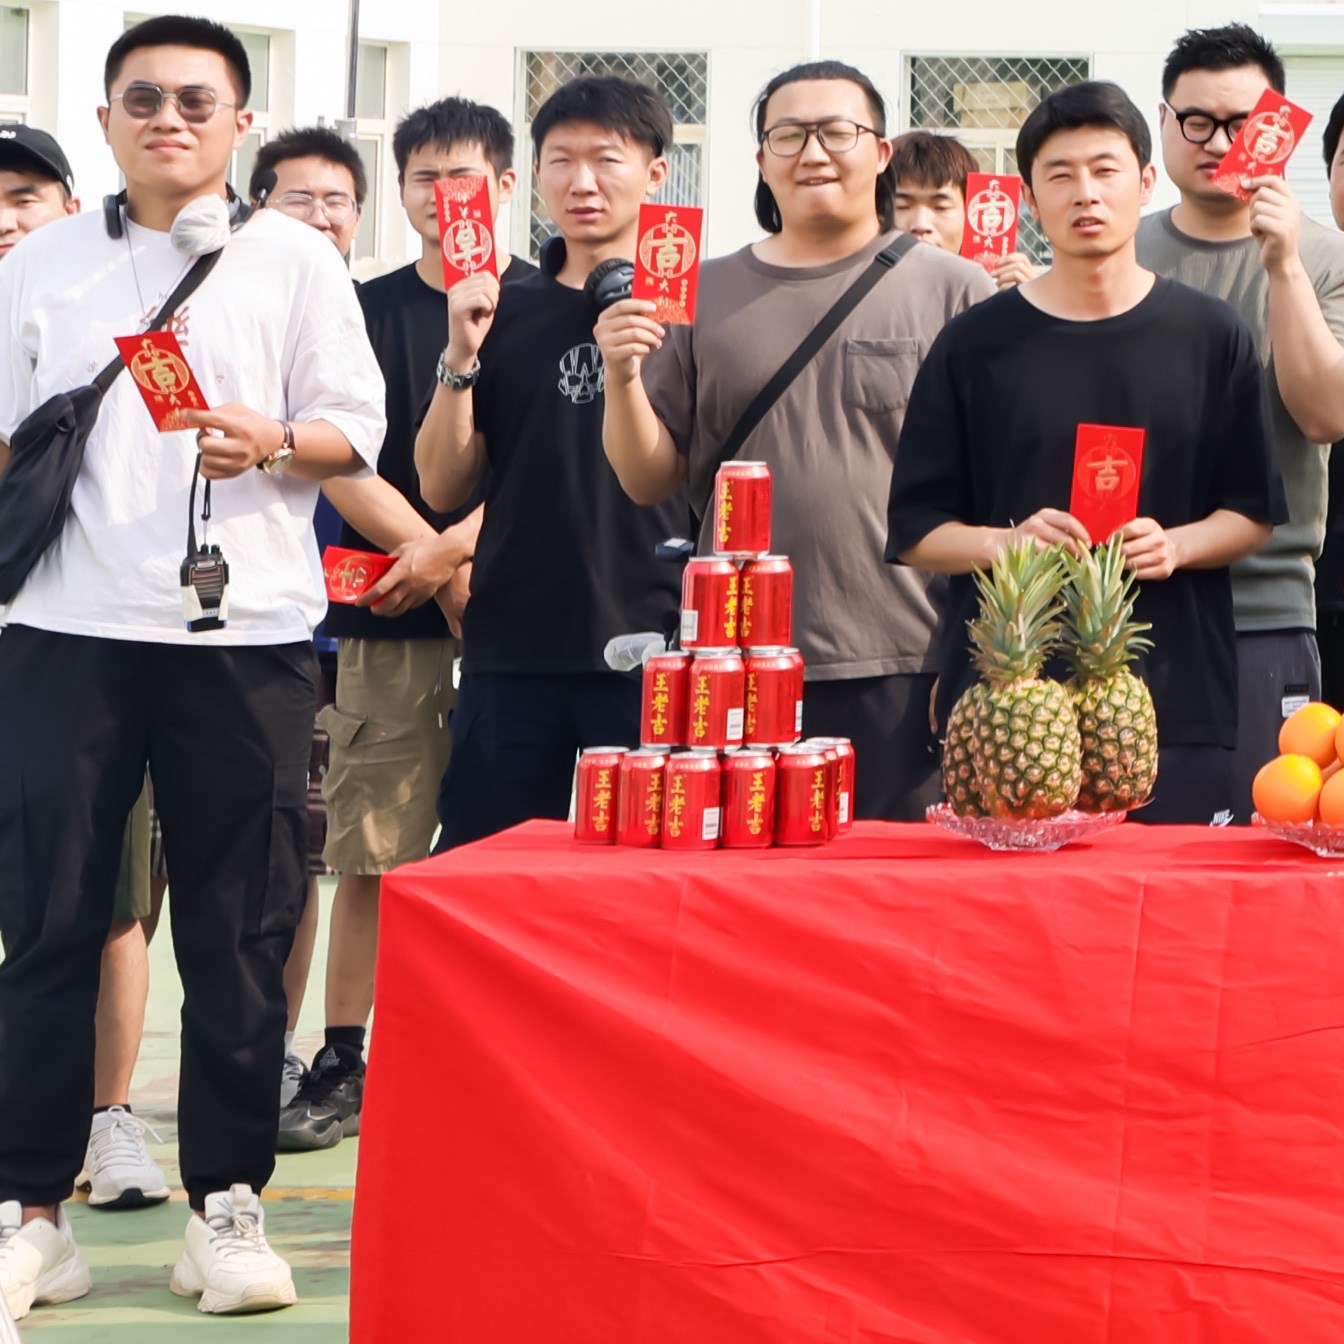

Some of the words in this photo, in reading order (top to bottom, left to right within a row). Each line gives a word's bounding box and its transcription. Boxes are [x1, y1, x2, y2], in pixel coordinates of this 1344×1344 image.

[651, 672, 670, 736] 王老吉
[693, 675, 711, 738] 王老吉
[592, 769, 612, 832] 王老吉
[668, 774, 686, 838] 王老吉
[747, 772, 766, 835] 王老吉
